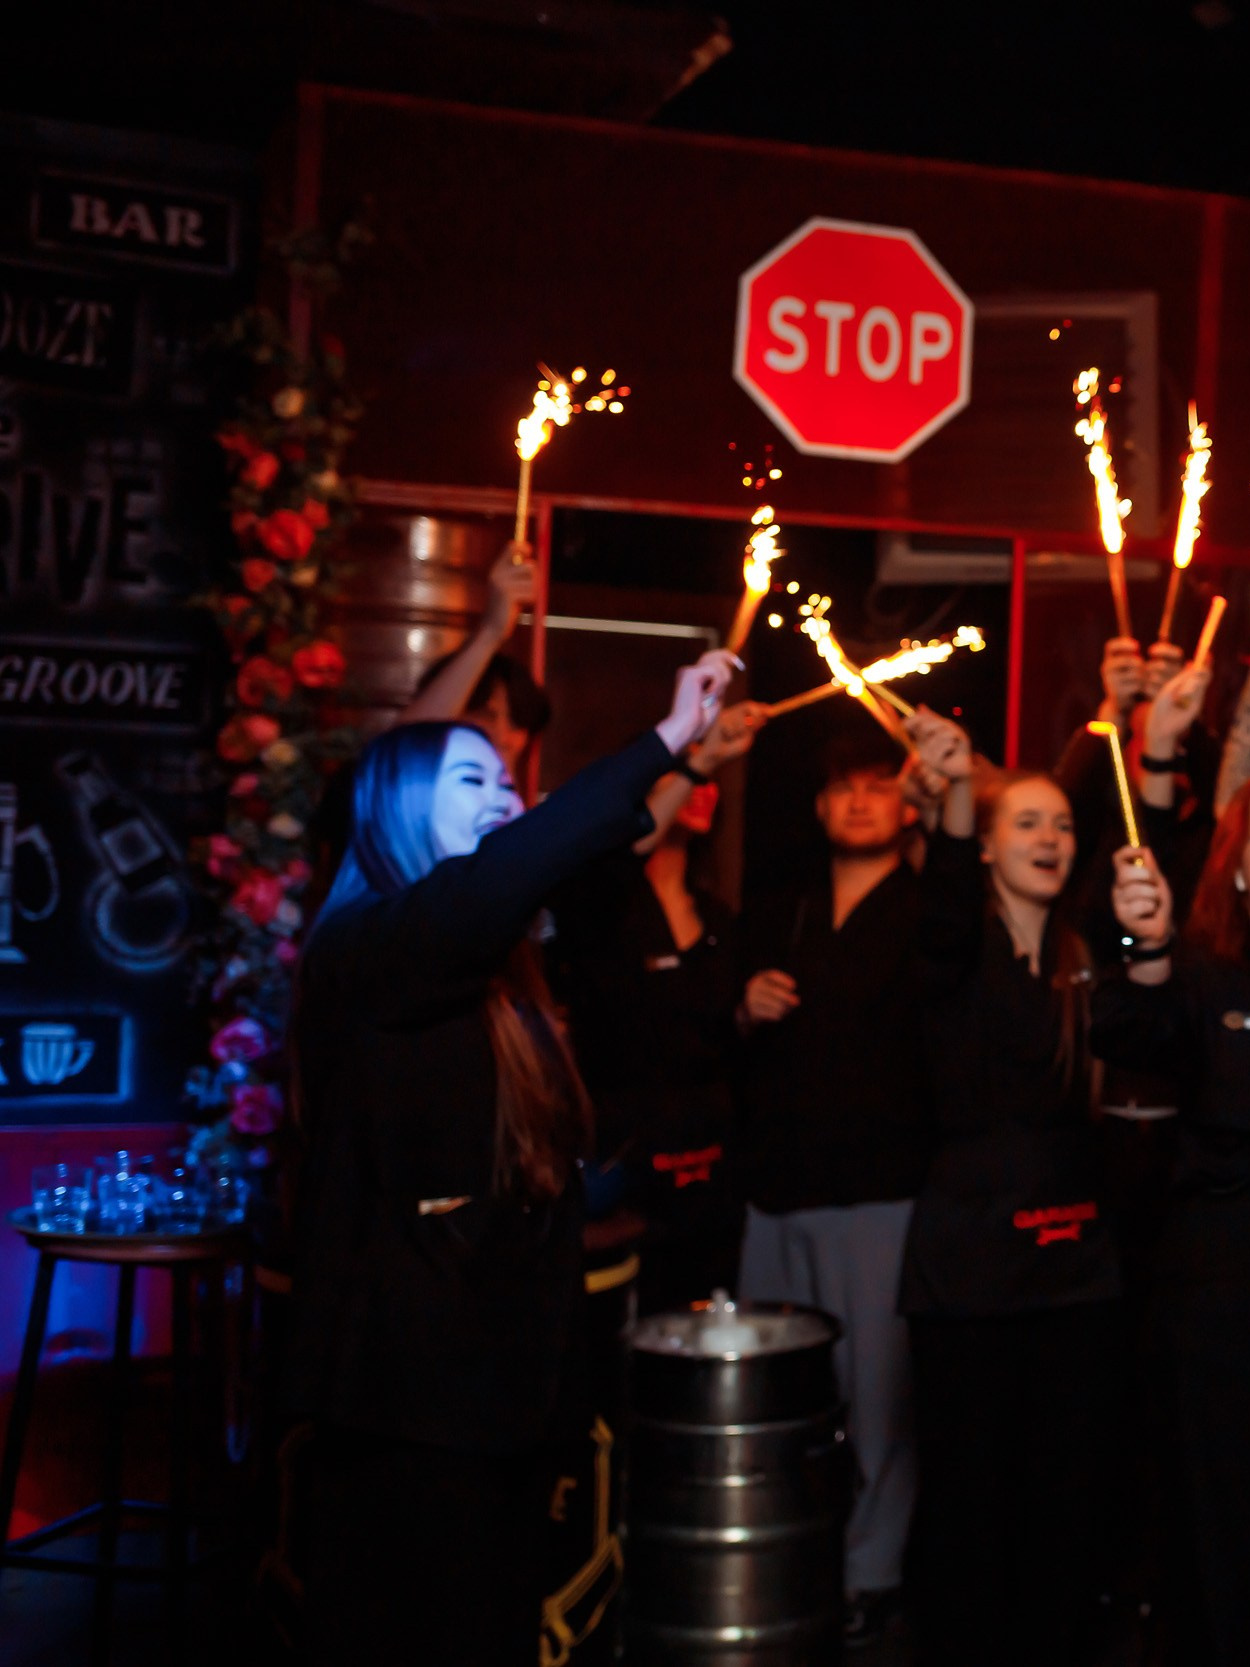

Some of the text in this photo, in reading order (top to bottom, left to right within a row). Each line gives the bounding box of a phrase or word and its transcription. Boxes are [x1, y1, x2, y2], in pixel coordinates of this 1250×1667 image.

[68, 192, 208, 248] BAR
[764, 296, 954, 385] STOP
[0, 654, 190, 709] GROOVE
